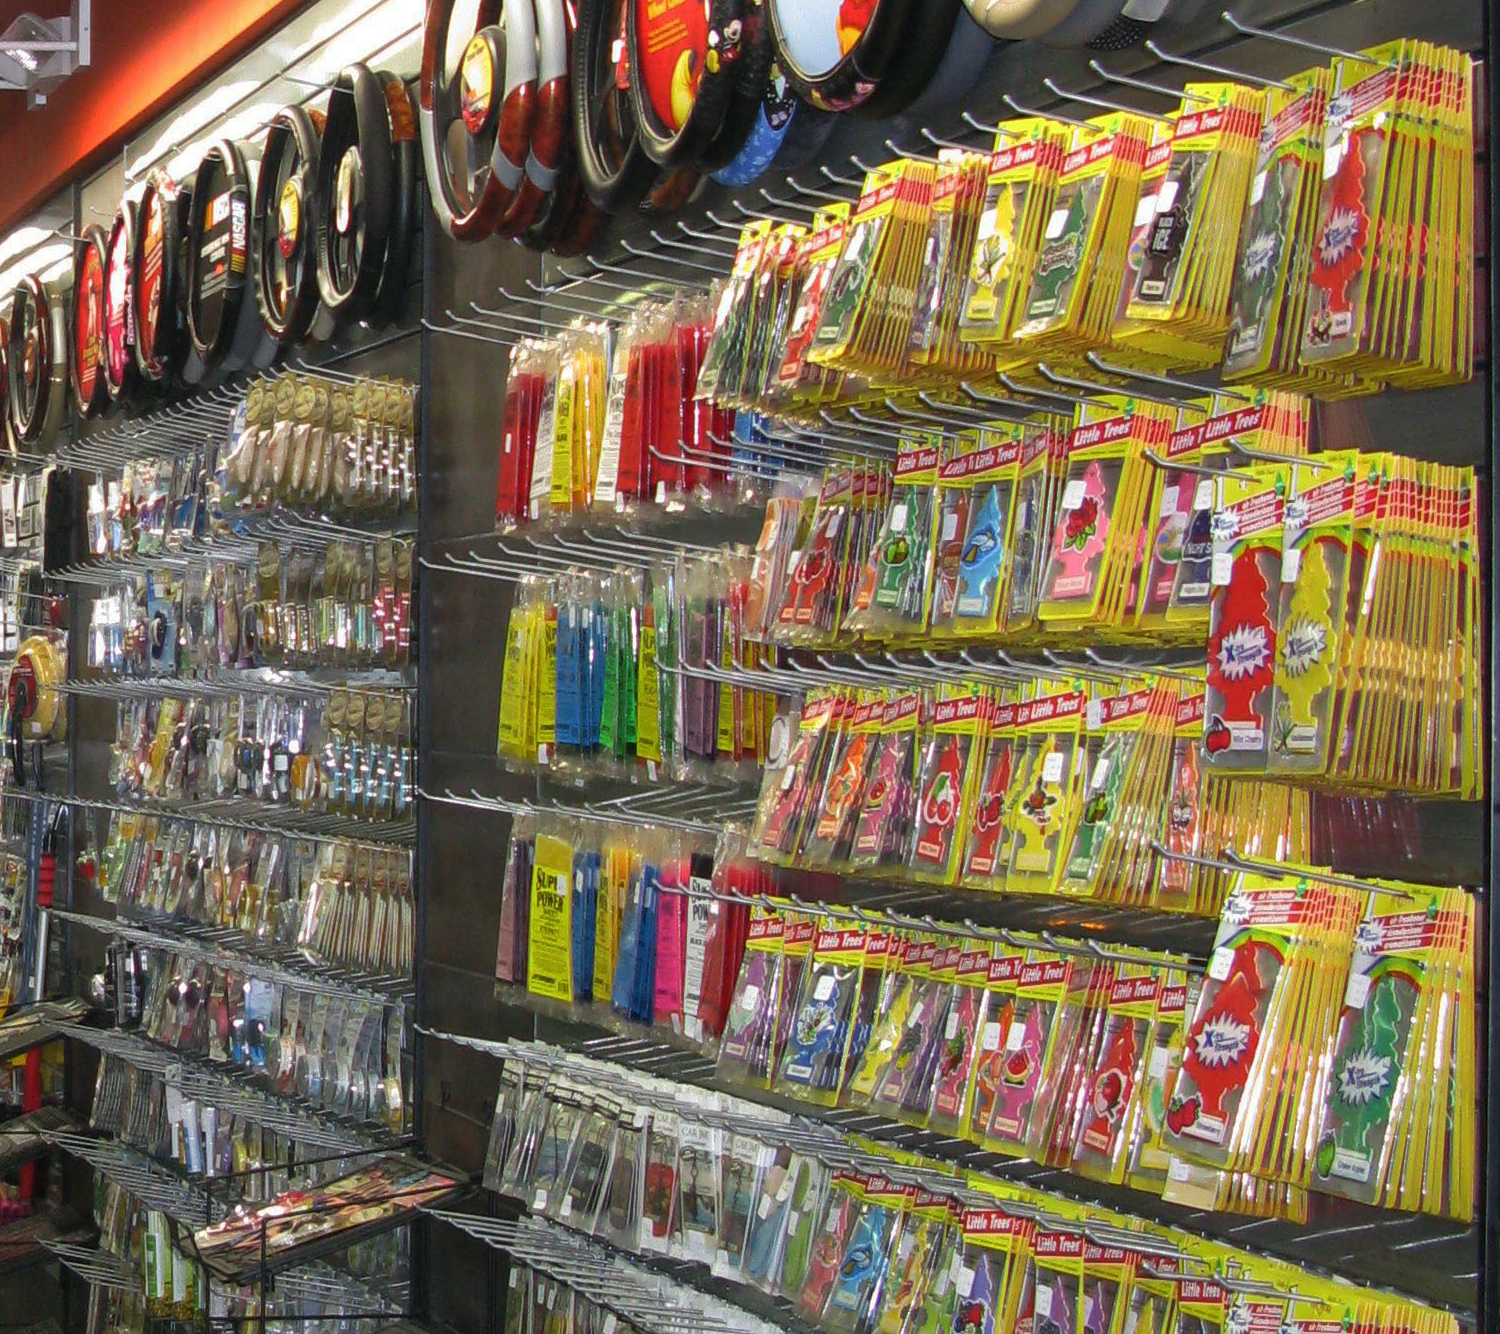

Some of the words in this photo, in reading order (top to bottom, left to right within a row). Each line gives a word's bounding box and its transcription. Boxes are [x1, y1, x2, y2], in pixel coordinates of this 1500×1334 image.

[231, 199, 246, 251] NASCAR
[1073, 425, 1101, 447] Little
[1103, 419, 1132, 441] Trees
[1205, 417, 1232, 439] Little
[1234, 410, 1261, 431] Trees
[1170, 432, 1195, 452] Little
[936, 704, 955, 721] Little
[957, 700, 977, 717] Trees
[1032, 700, 1054, 719] Little
[1057, 694, 1079, 713] Trees
[818, 932, 840, 949] Little
[841, 930, 864, 947] Trees
[1022, 967, 1042, 983] Little
[1043, 963, 1065, 980] Trees
[966, 1214, 987, 1230] Little
[990, 1215, 1011, 1230] Trees
[1037, 1235, 1057, 1252] Little
[1059, 1236, 1081, 1252] Trees
[1181, 1282, 1200, 1297] Little
[1202, 1283, 1220, 1298] Trees
